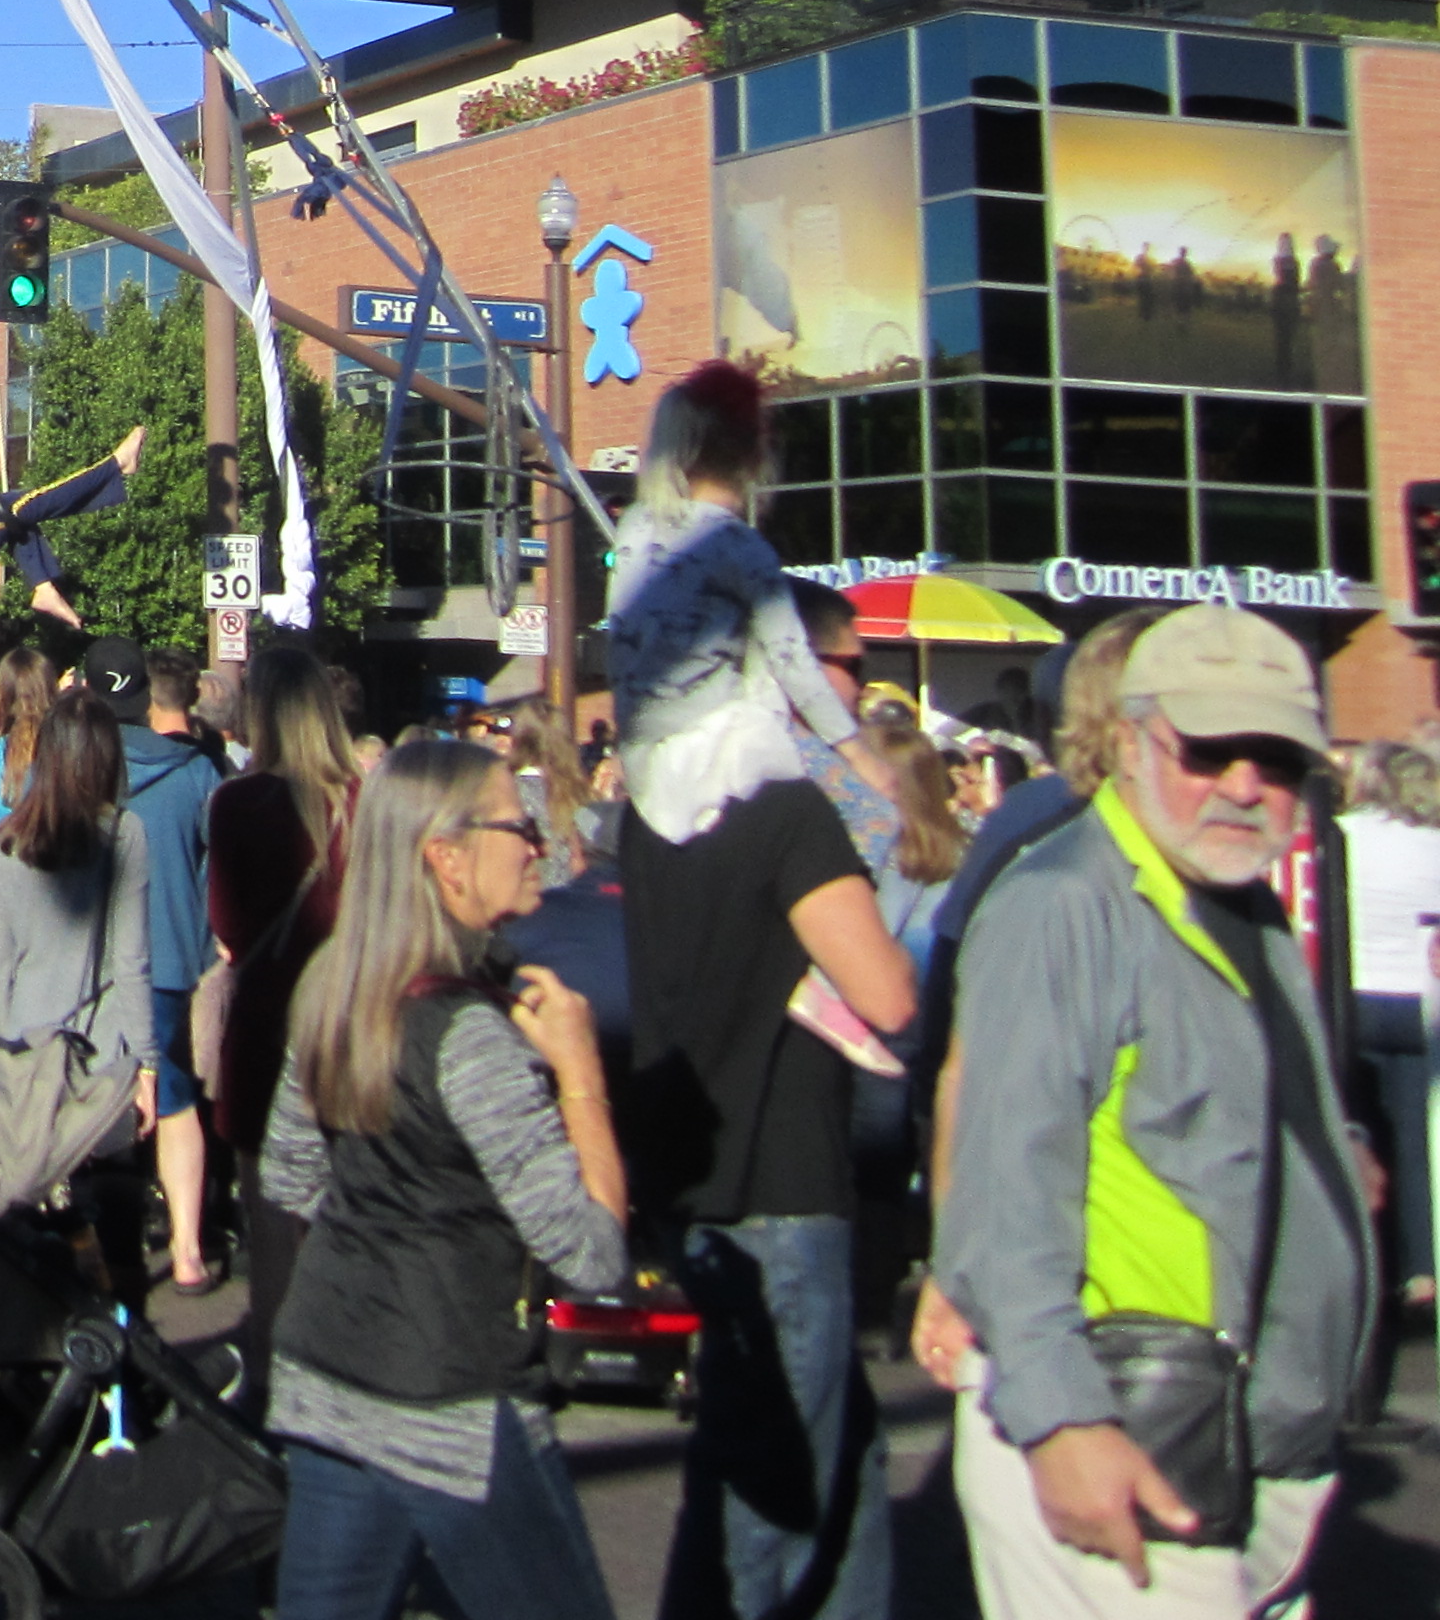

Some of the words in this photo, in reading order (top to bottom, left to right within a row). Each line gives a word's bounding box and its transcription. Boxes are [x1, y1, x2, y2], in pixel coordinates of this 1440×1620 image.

[371, 299, 449, 326] Fifh
[209, 541, 253, 554] SPEED
[212, 557, 249, 569] LIMIT
[210, 574, 252, 599] 30
[1248, 565, 1350, 608] Bank
